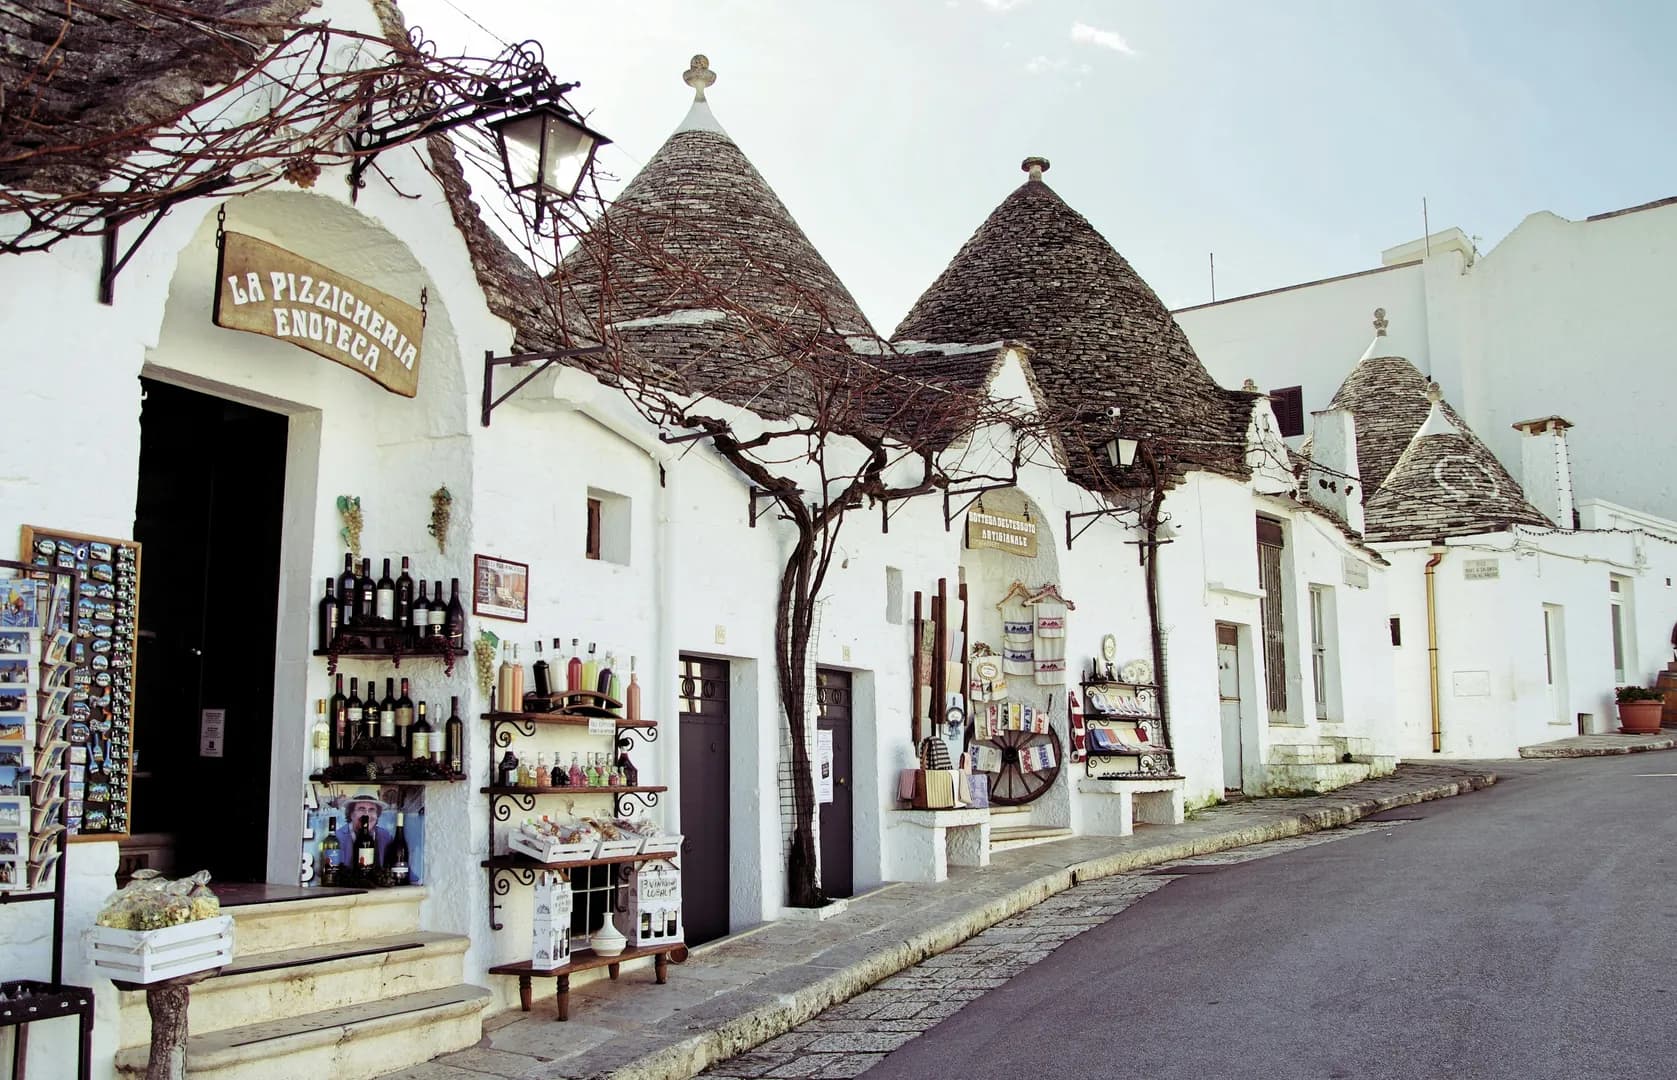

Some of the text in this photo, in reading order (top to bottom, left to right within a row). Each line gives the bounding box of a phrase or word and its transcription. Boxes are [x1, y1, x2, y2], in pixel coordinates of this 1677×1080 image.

[228, 271, 417, 371] LA PIZZICHERIA
[273, 308, 380, 372] ENOTECA
[982, 529, 1028, 547] ARTIGIANALE
